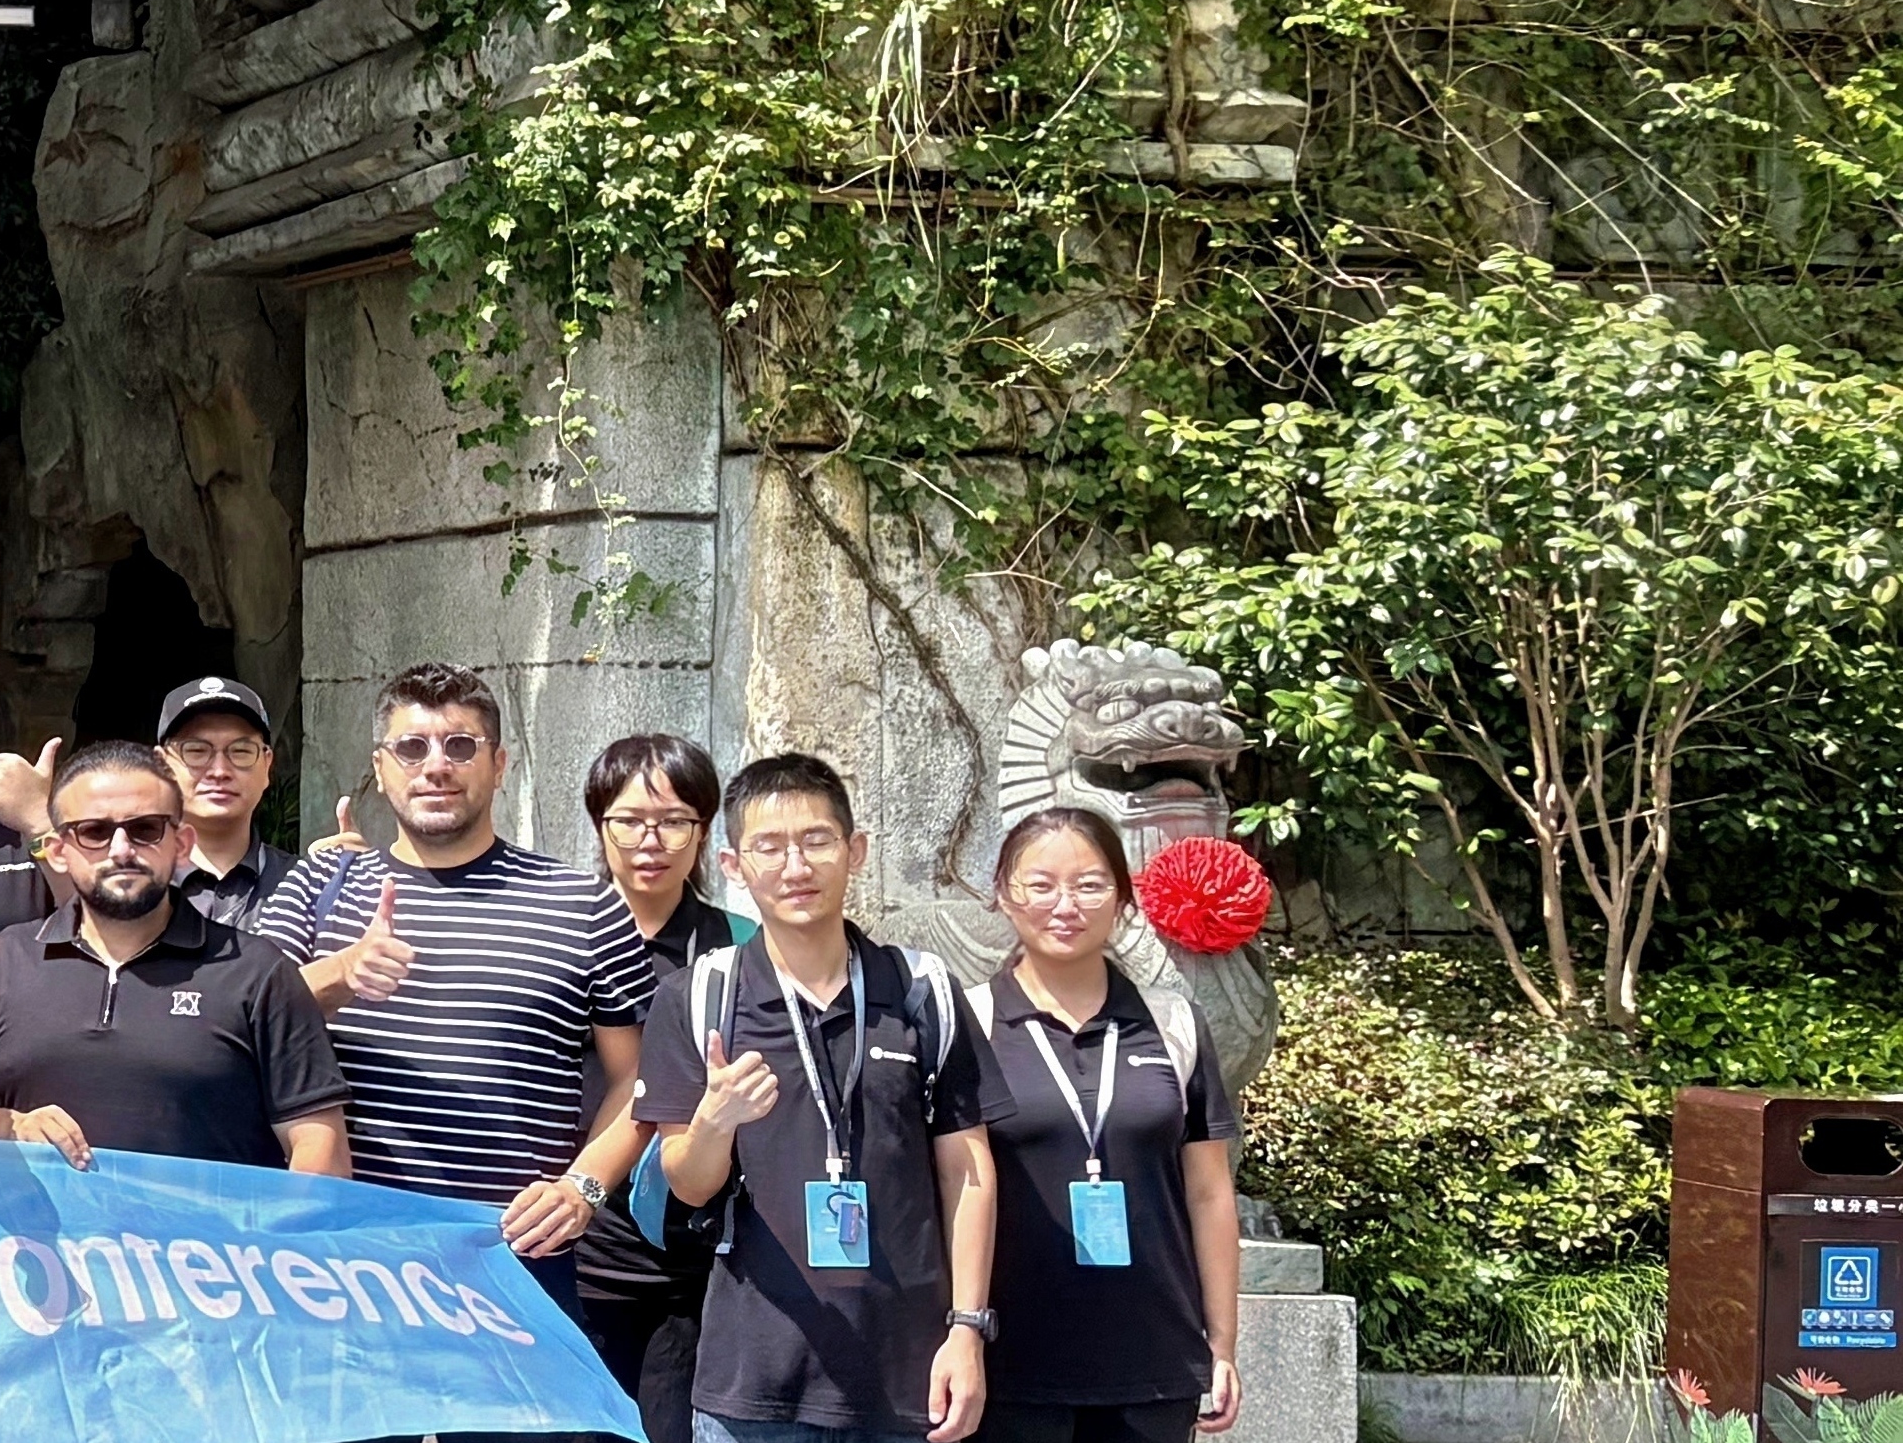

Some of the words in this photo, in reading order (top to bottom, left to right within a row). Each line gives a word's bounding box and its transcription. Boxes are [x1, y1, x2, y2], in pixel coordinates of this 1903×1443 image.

[1814, 1198, 1903, 1214] 垃圾分类一
